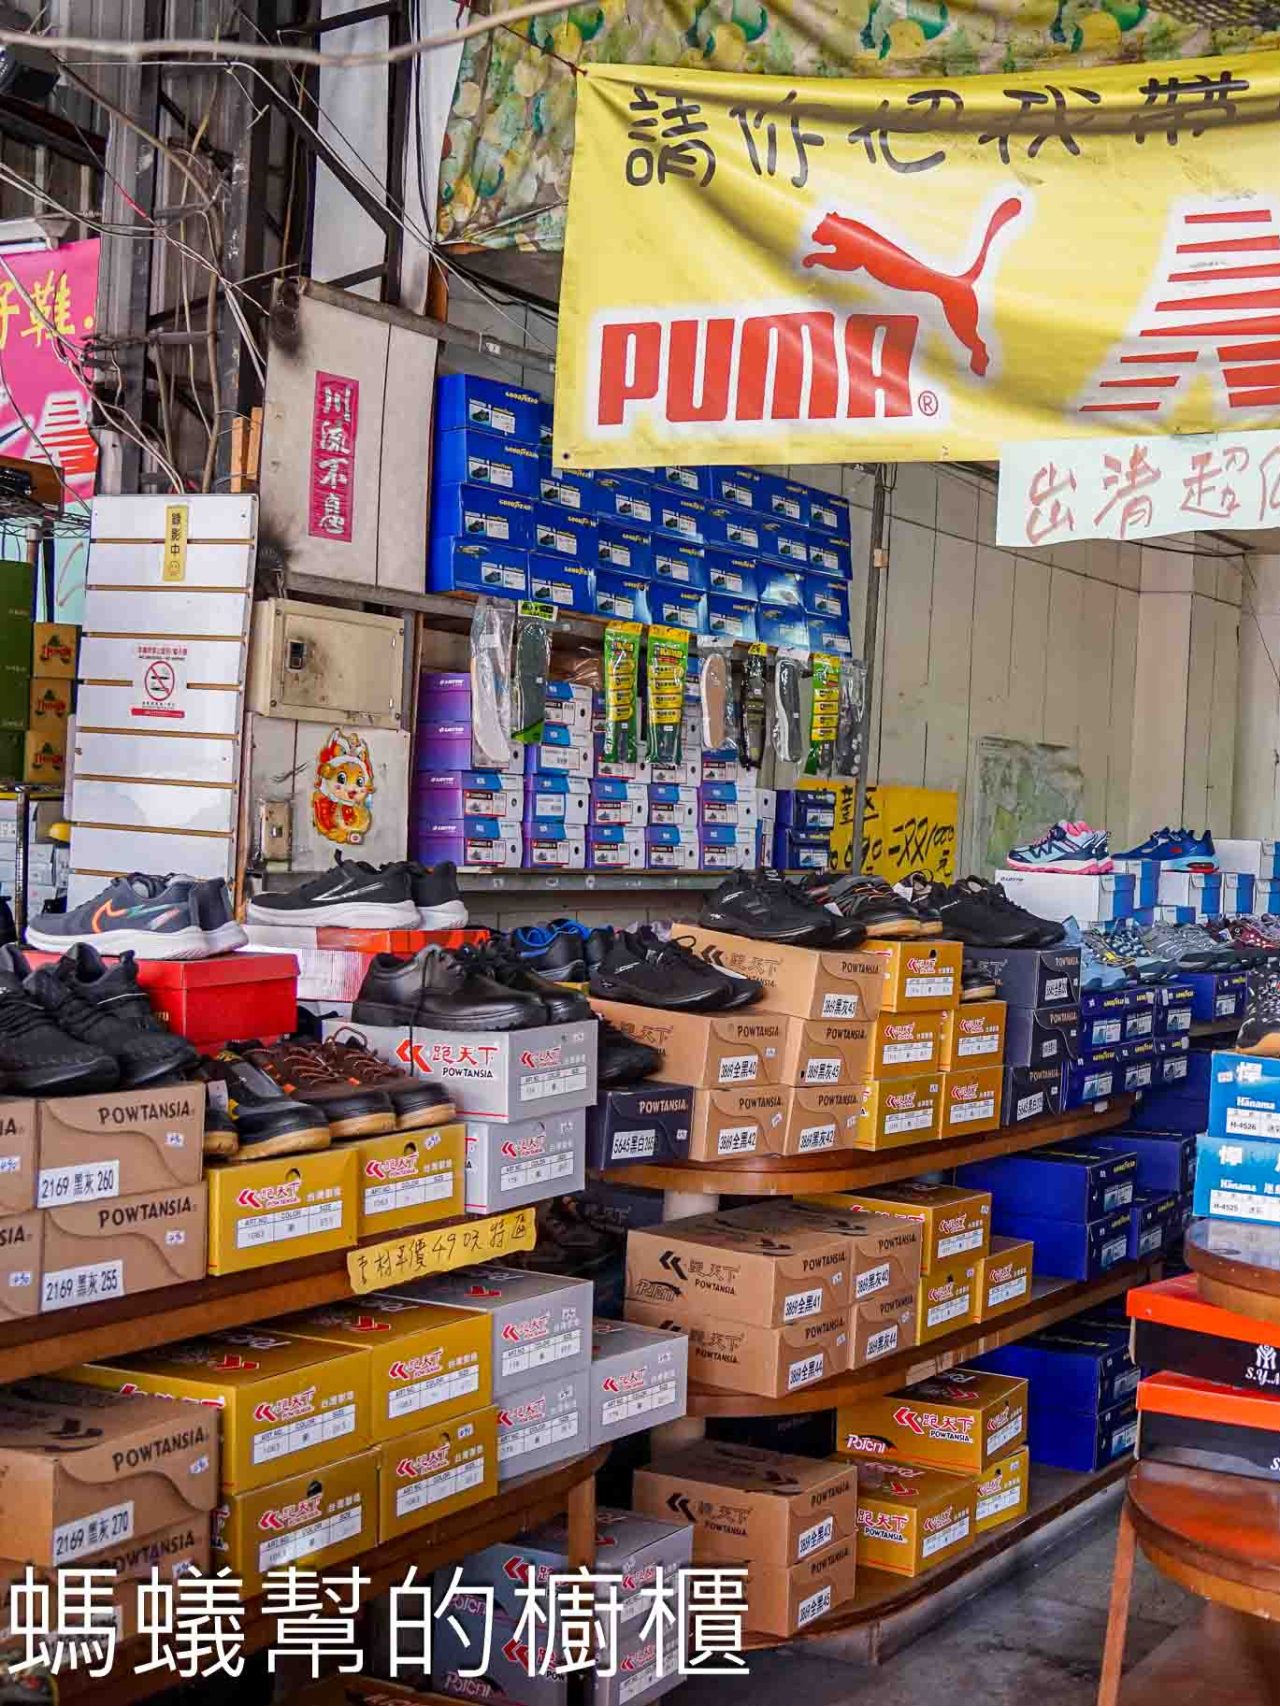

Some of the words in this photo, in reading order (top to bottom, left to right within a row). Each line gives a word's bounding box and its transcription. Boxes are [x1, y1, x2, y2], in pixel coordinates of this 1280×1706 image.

[598, 311, 919, 425] PUMA
[432, 1046, 498, 1066] 跑天下
[442, 1067, 494, 1078] POWTANSIA
[98, 1101, 191, 1125] POWTANSIA
[638, 1098, 687, 1114] POWTANSIA
[42, 1177, 70, 1199] 2169
[97, 1169, 114, 1192] 260
[98, 1197, 192, 1229] POWTANSIA
[802, 1251, 846, 1272] POWTANSIA
[46, 1278, 74, 1302] 2169
[100, 1268, 118, 1293] 255
[694, 1278, 736, 1296] POWTANSIA
[921, 1412, 975, 1433] 跑天下
[930, 1429, 972, 1443] POWTANSIA
[112, 1426, 207, 1472] POWTANSIA
[857, 1509, 909, 1532] 跑天下
[56, 1532, 85, 1556] 2169
[111, 1511, 130, 1533] 270
[865, 1526, 905, 1543] POWTANSIA
